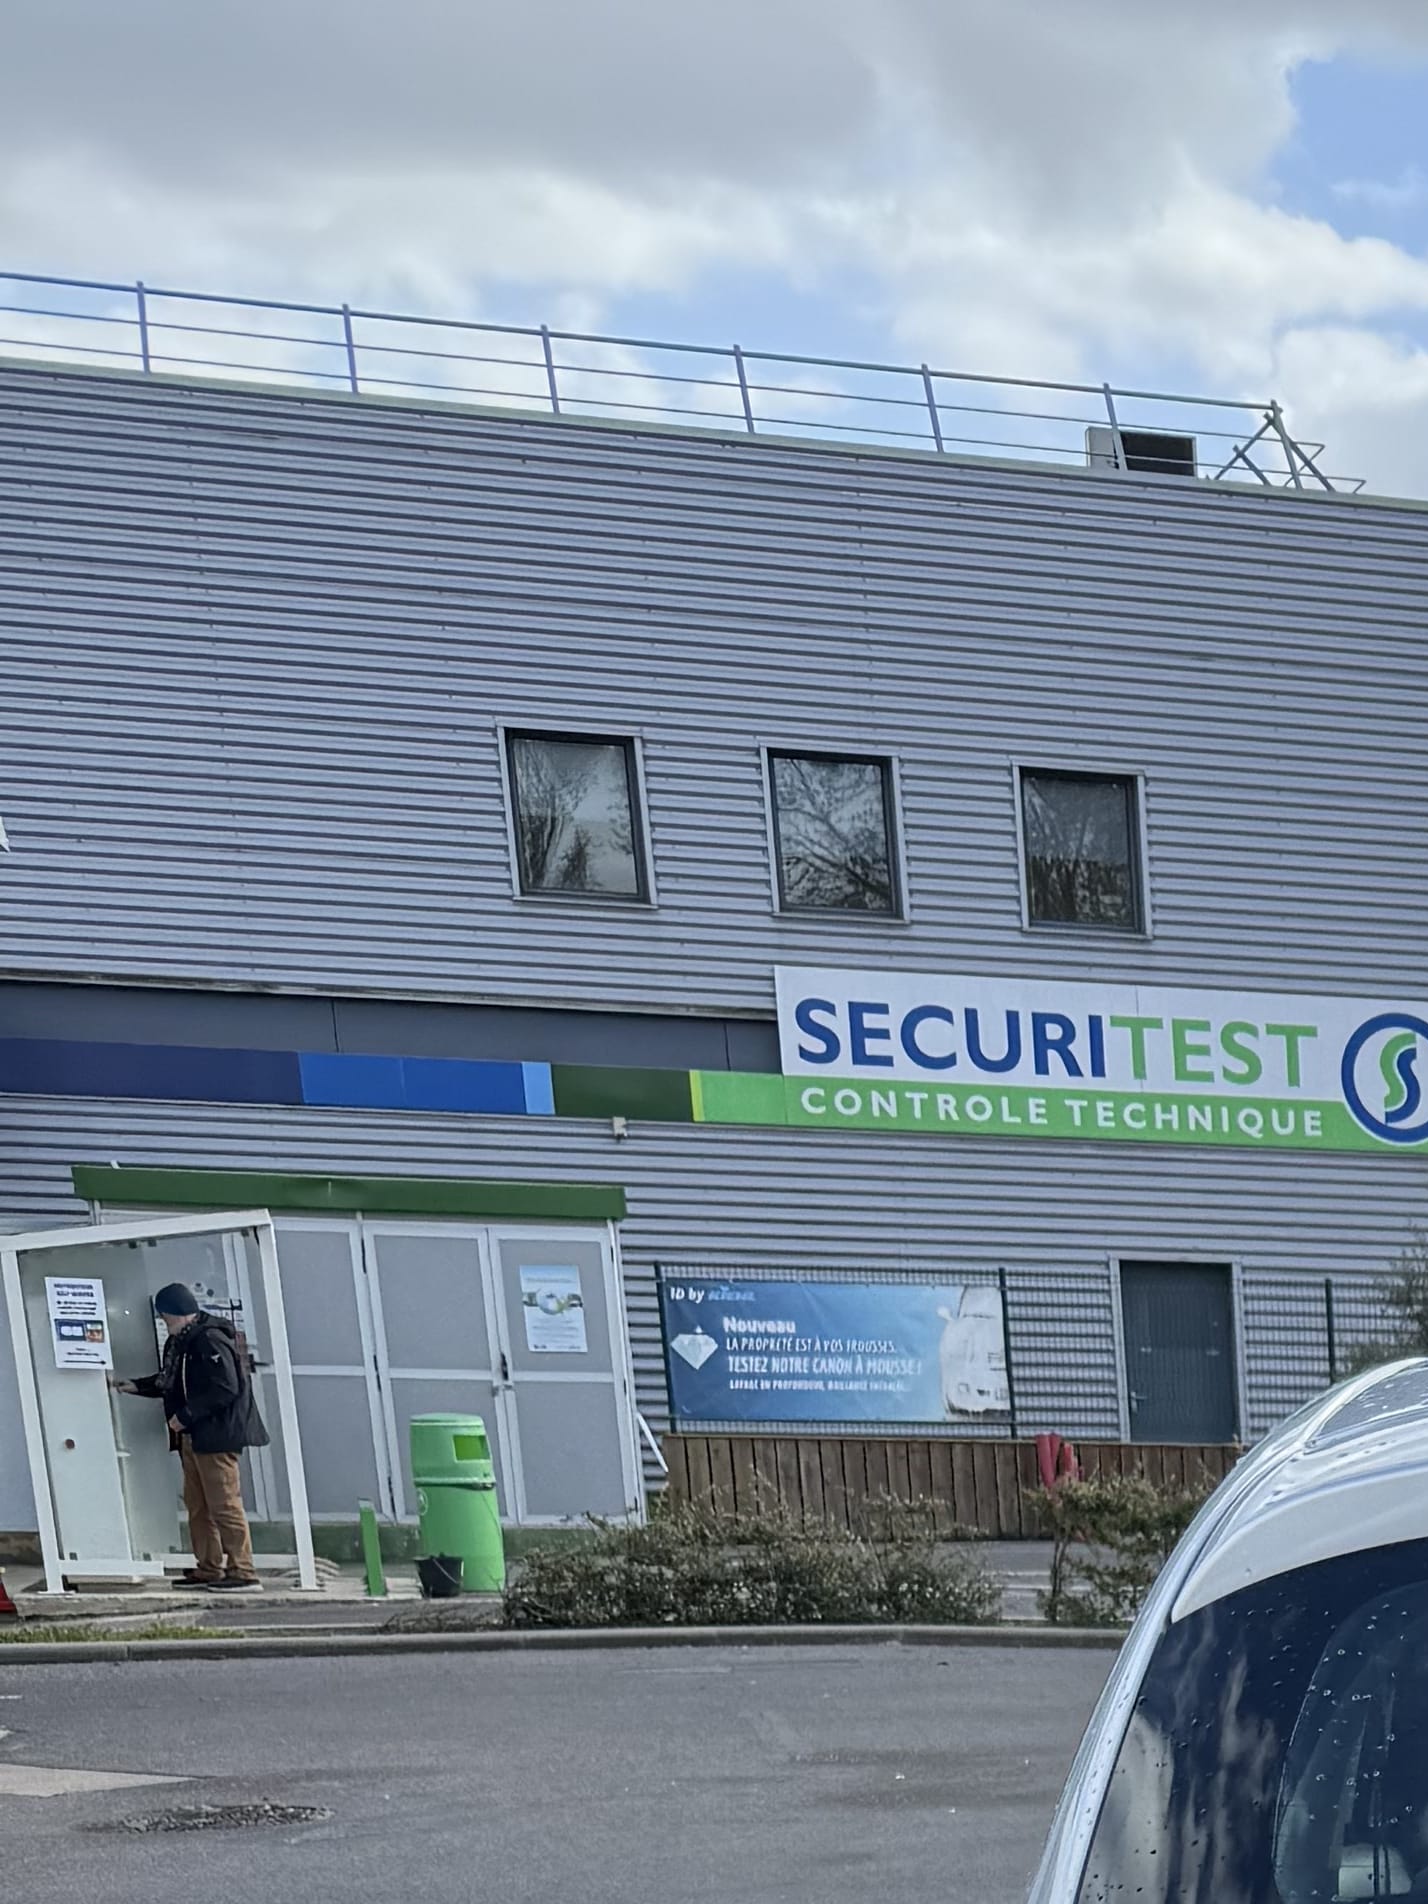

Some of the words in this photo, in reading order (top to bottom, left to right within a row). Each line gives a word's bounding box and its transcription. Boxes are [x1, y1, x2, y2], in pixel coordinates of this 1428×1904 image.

[795, 997, 1319, 1089] SECURITEST
[800, 1086, 1048, 1126] CONTROLE
[1064, 1098, 1324, 1139] TECHNIQUE
[688, 1287, 705, 1304] by
[722, 1316, 796, 1334] Nouveau
[726, 1337, 739, 1351] LA
[795, 1338, 812, 1352] EST
[824, 1338, 844, 1353] VOS
[728, 1355, 769, 1373] TESTEZ
[771, 1356, 809, 1374] NOTRE
[812, 1356, 853, 1375] CANON
